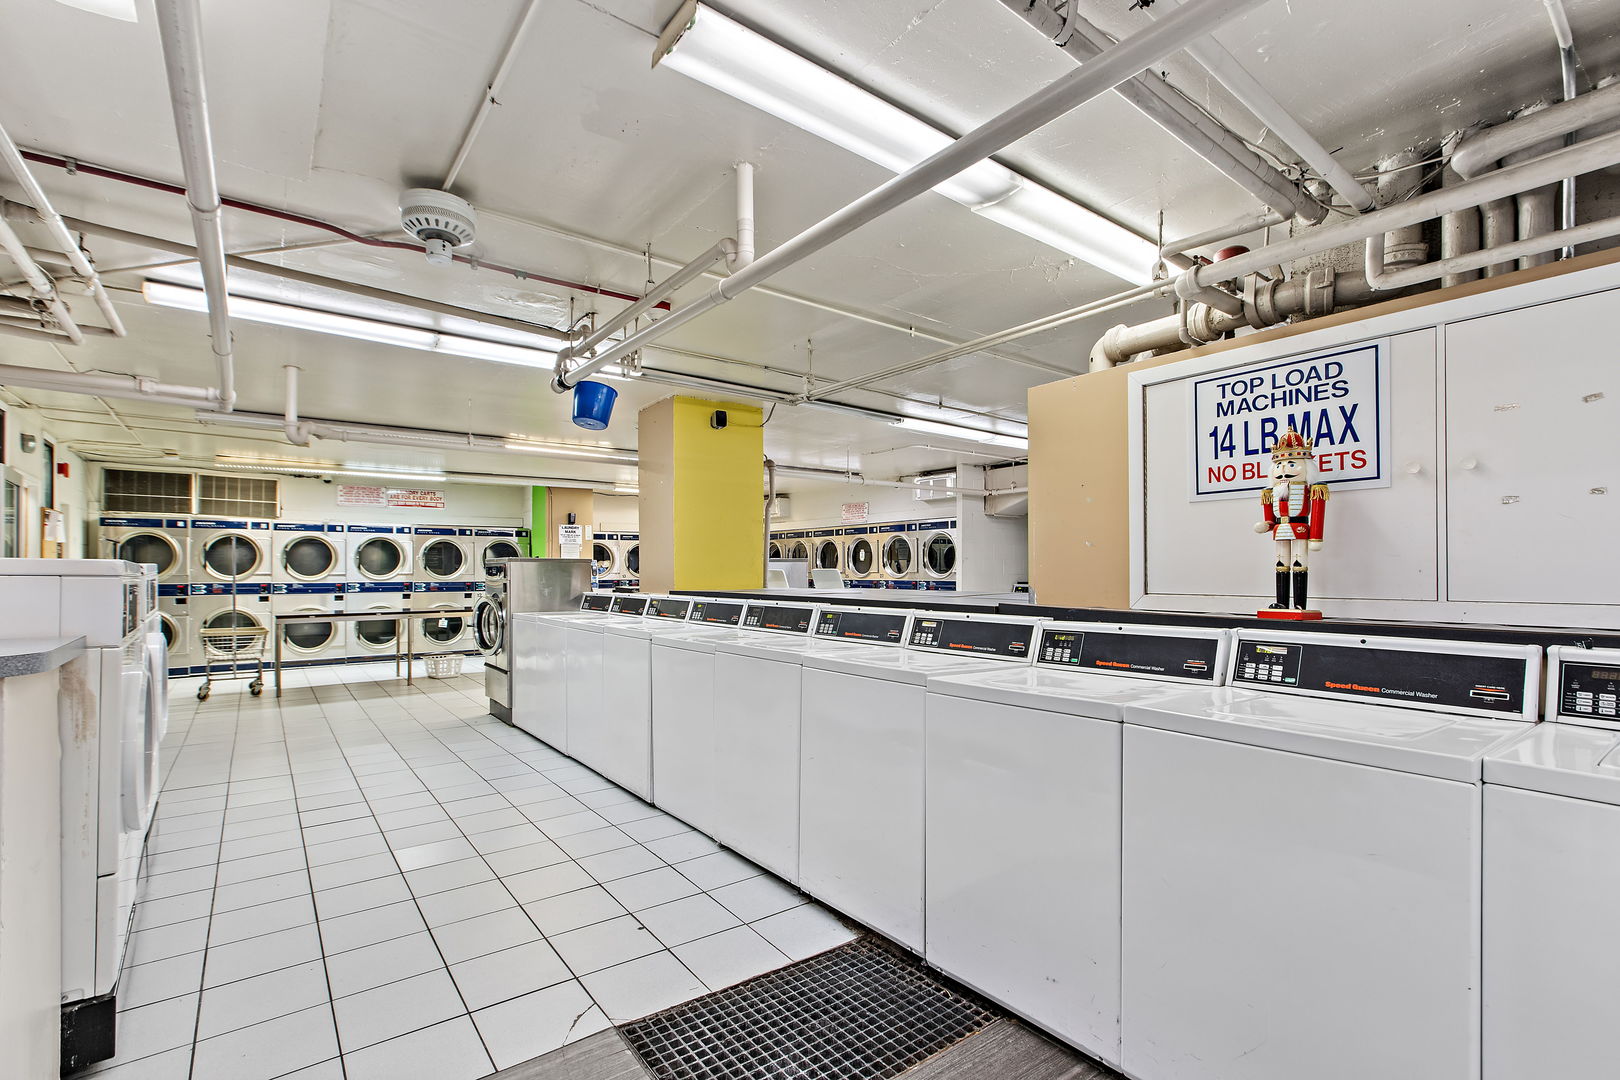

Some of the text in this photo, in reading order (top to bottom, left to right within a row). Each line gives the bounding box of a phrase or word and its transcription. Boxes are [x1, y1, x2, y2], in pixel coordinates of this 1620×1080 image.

[1216, 361, 1343, 400] TOP LOAD
[1216, 379, 1350, 418] MACHINES
[1208, 423, 1237, 460] 14
[1244, 416, 1279, 456] LB
[1208, 449, 1367, 484] NO BLETS
[1324, 681, 1438, 699] Speed Queen Commercial Washer
